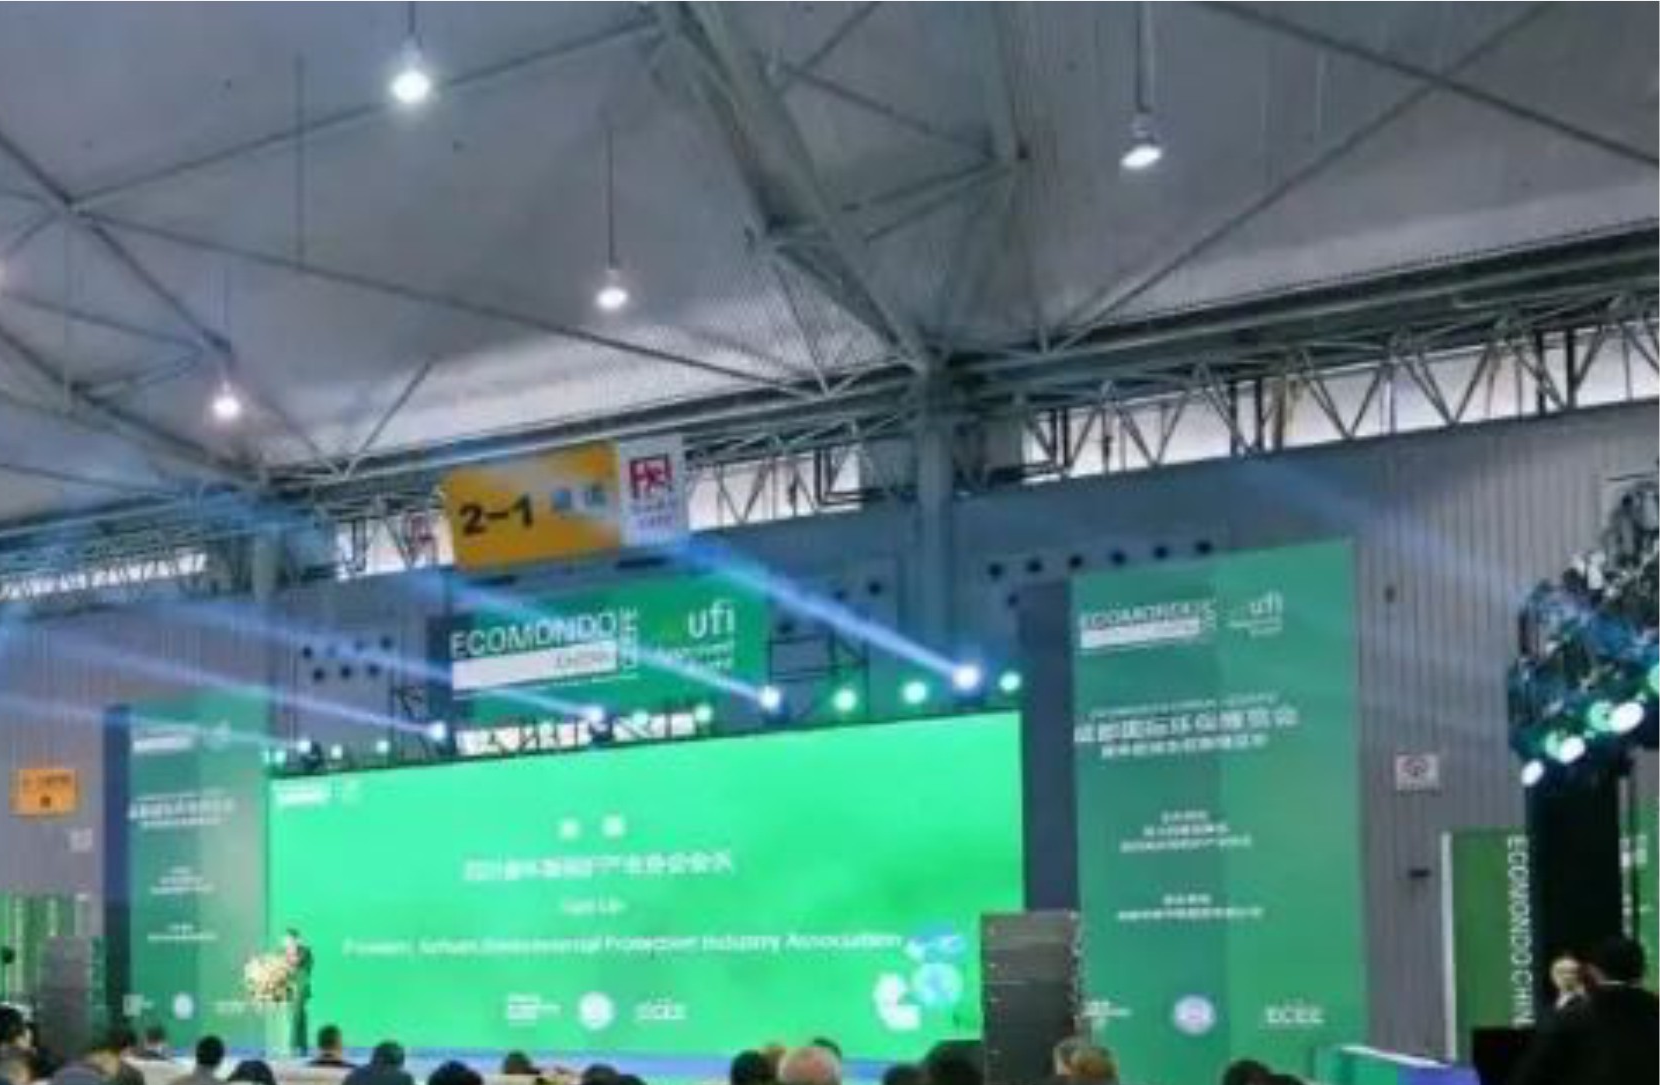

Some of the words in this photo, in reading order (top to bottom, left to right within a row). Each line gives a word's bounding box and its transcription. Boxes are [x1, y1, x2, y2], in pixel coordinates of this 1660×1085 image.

[459, 491, 533, 535] 2-1
[450, 611, 617, 660] ECOMONDO
[689, 600, 735, 638] ufi
[1506, 834, 1533, 965] ECOMONDO
